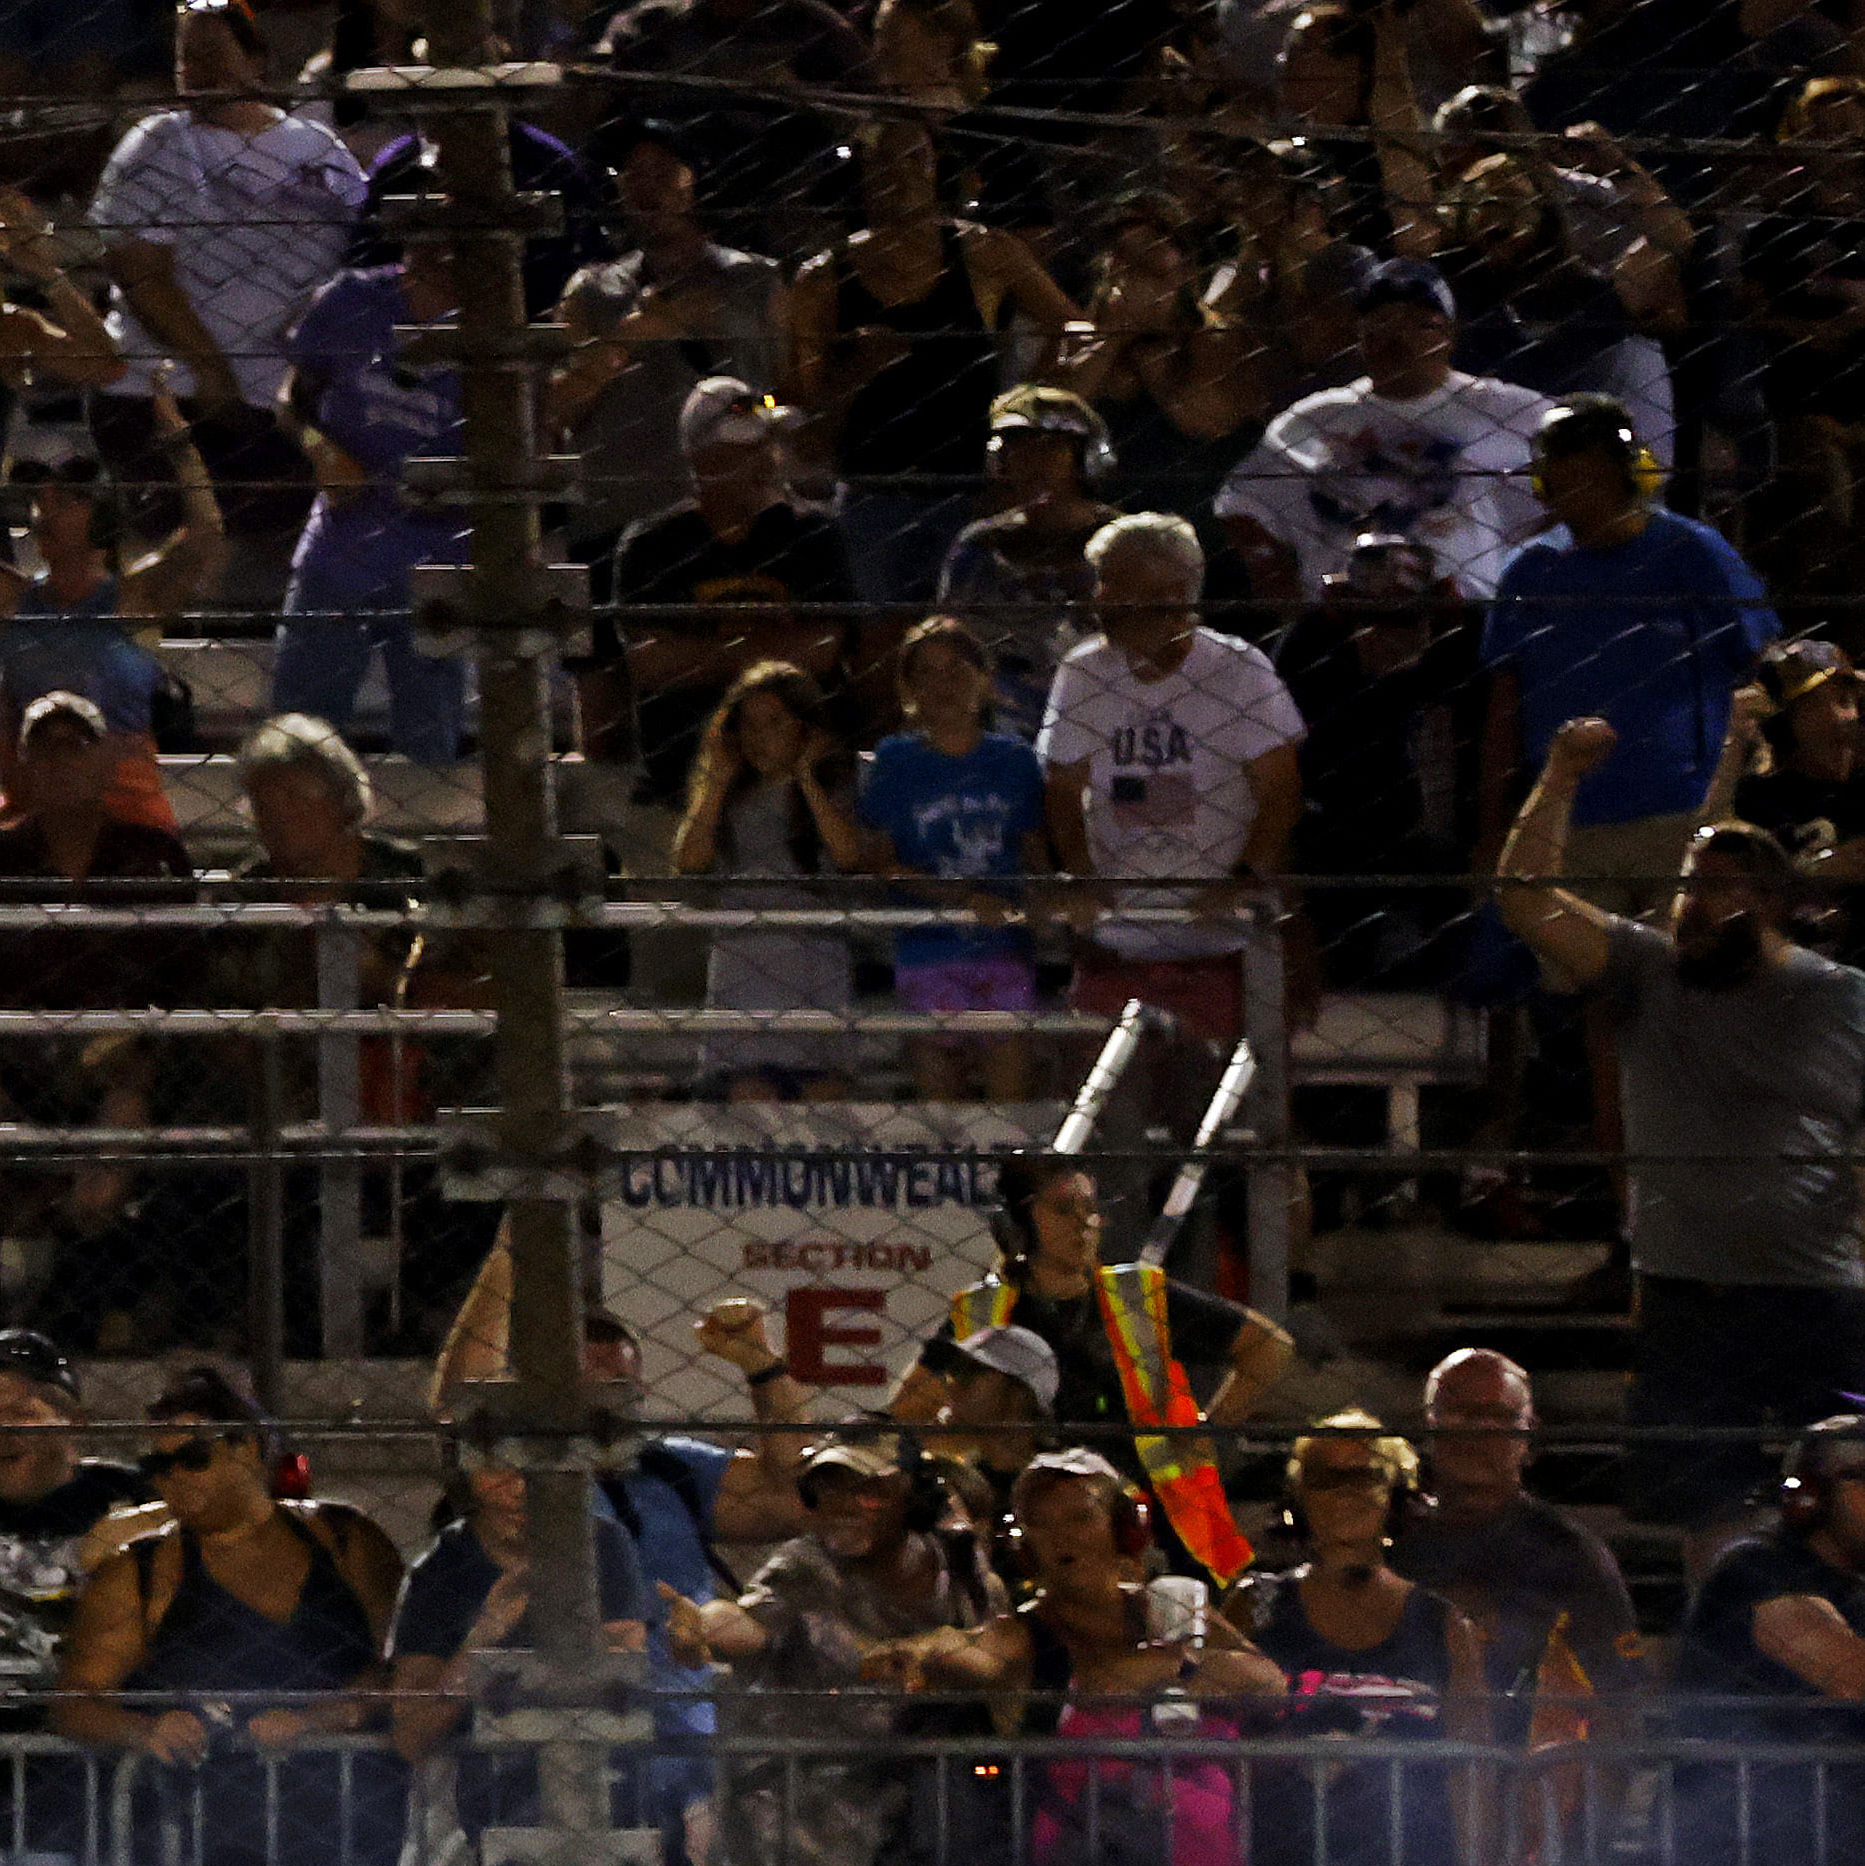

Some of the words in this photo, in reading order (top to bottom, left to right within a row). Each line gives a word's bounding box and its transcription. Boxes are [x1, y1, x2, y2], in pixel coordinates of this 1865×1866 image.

[1111, 724, 1193, 767] USA
[623, 1143, 1019, 1209] COMMONWEAL
[742, 1240, 932, 1271] SECTION
[785, 1286, 887, 1386] E
